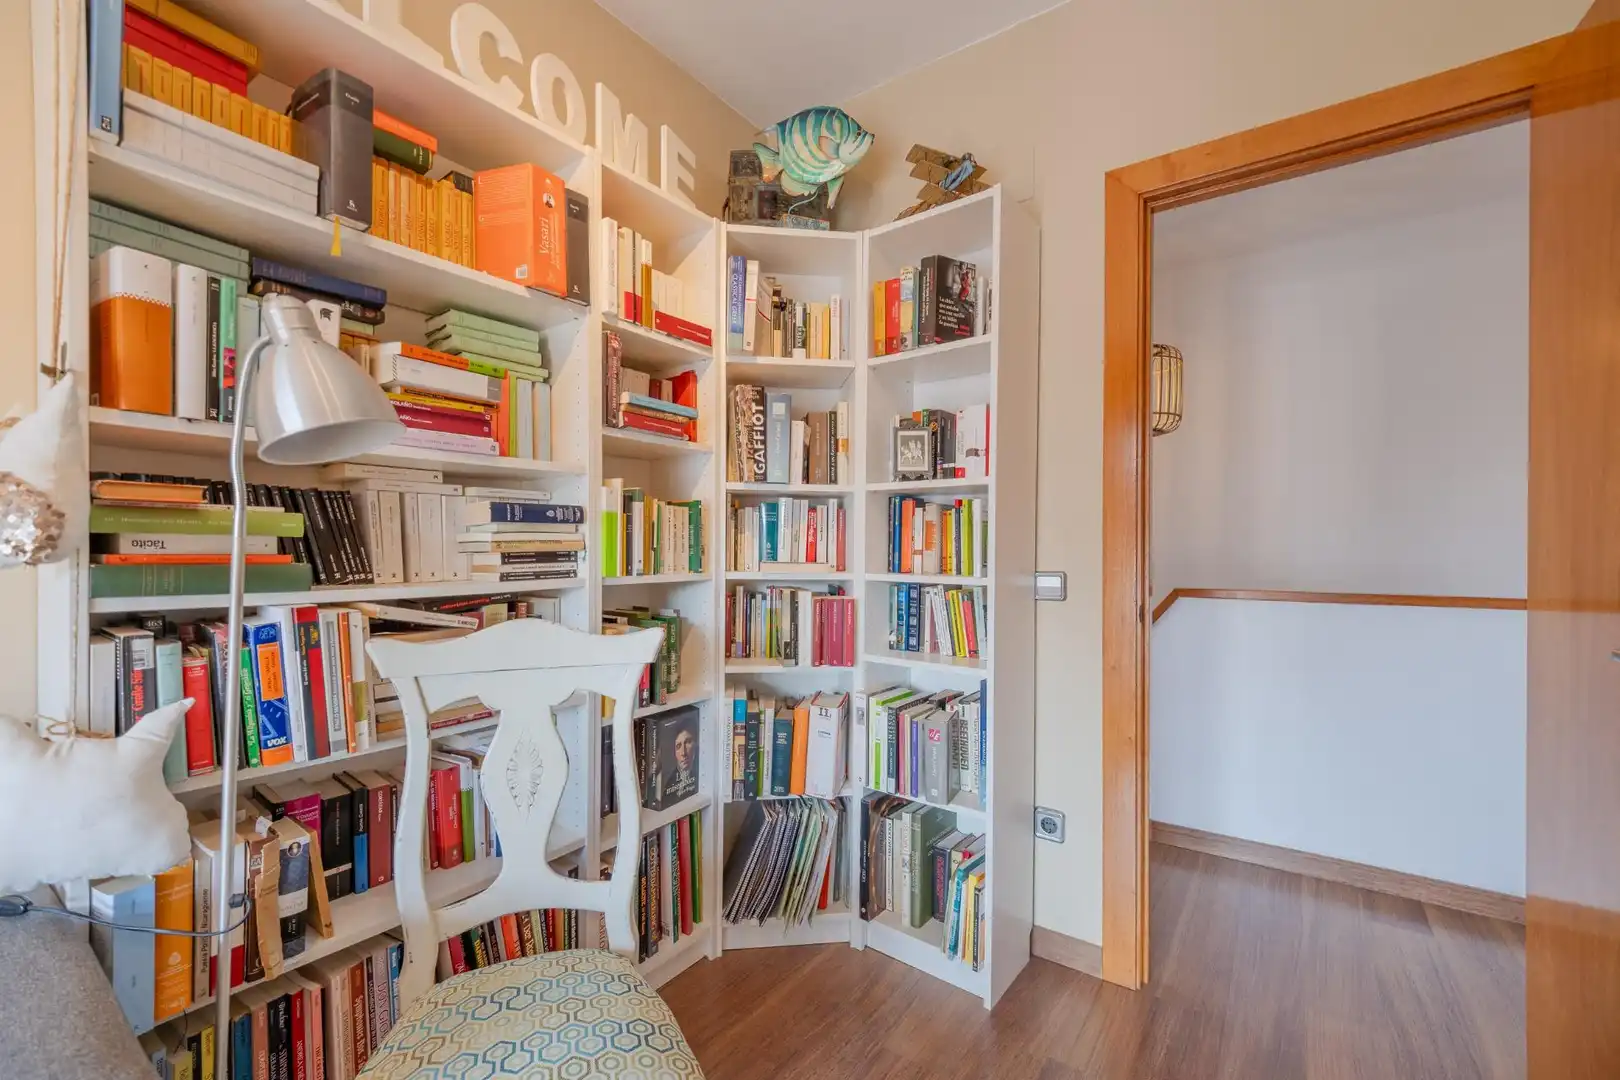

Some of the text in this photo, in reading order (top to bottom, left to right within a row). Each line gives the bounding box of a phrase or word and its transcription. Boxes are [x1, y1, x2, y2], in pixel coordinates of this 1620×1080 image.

[539, 216, 550, 255] Vasari
[753, 401, 764, 474] GAFFIOT
[131, 539, 167, 549] Tácito
[266, 736, 288, 747] VOX
[960, 719, 969, 771] BEETHOVEN
[377, 981, 389, 1008] DON
